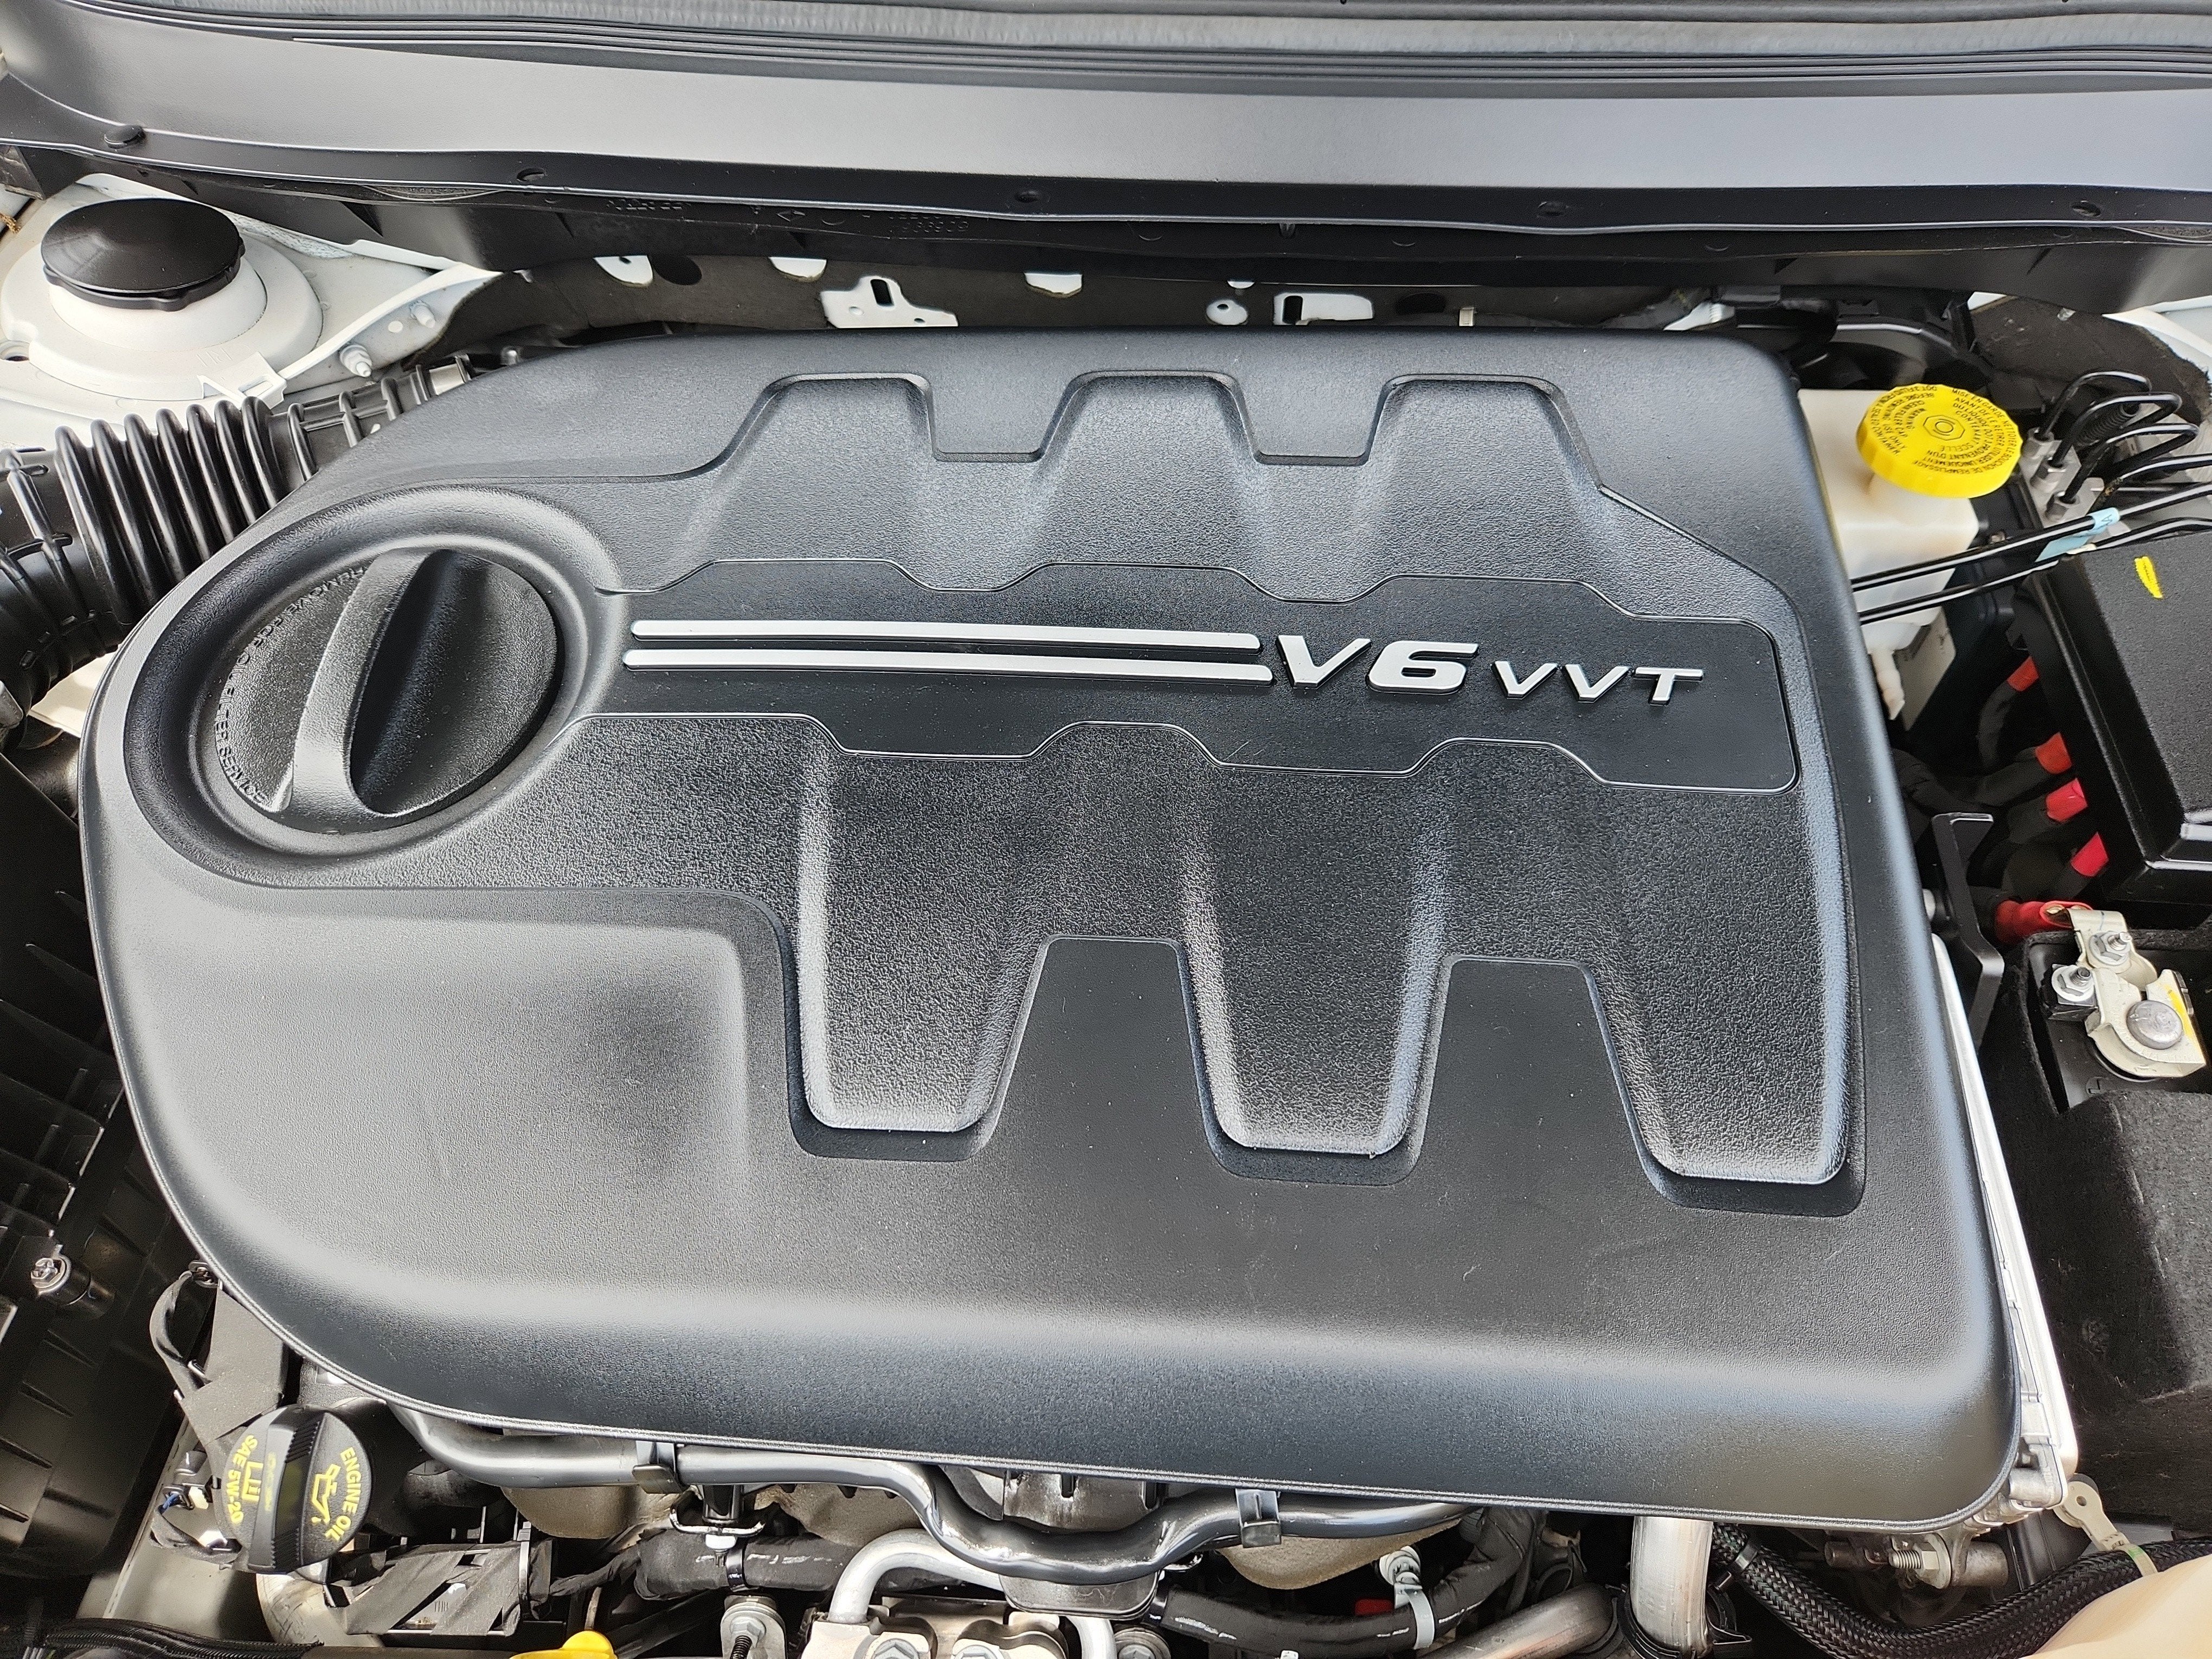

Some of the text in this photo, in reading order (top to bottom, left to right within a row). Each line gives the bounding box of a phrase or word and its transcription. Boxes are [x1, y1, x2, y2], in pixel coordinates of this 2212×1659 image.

[1951, 389, 1970, 397] MISE
[1954, 410, 1983, 445] CONTENANT
[1954, 396, 1980, 409] AVANT
[1976, 446, 2002, 464] UTILISER
[1963, 408, 1991, 427] LIQUIDE
[2000, 420, 2017, 447] NETTOYER
[1888, 435, 1907, 449] ONLY
[1949, 442, 1991, 460] PROVENANT
[1982, 453, 2012, 471] BOUCHON
[244, 615, 284, 654] FOR
[228, 652, 250, 680] OIL
[1276, 634, 1704, 705] V6 VVT
[215, 686, 235, 742] FILTER
[218, 746, 272, 806] SERVICE
[226, 1435, 258, 1524] SAE 5W-20
[325, 1446, 362, 1541] ENGINE OIL
